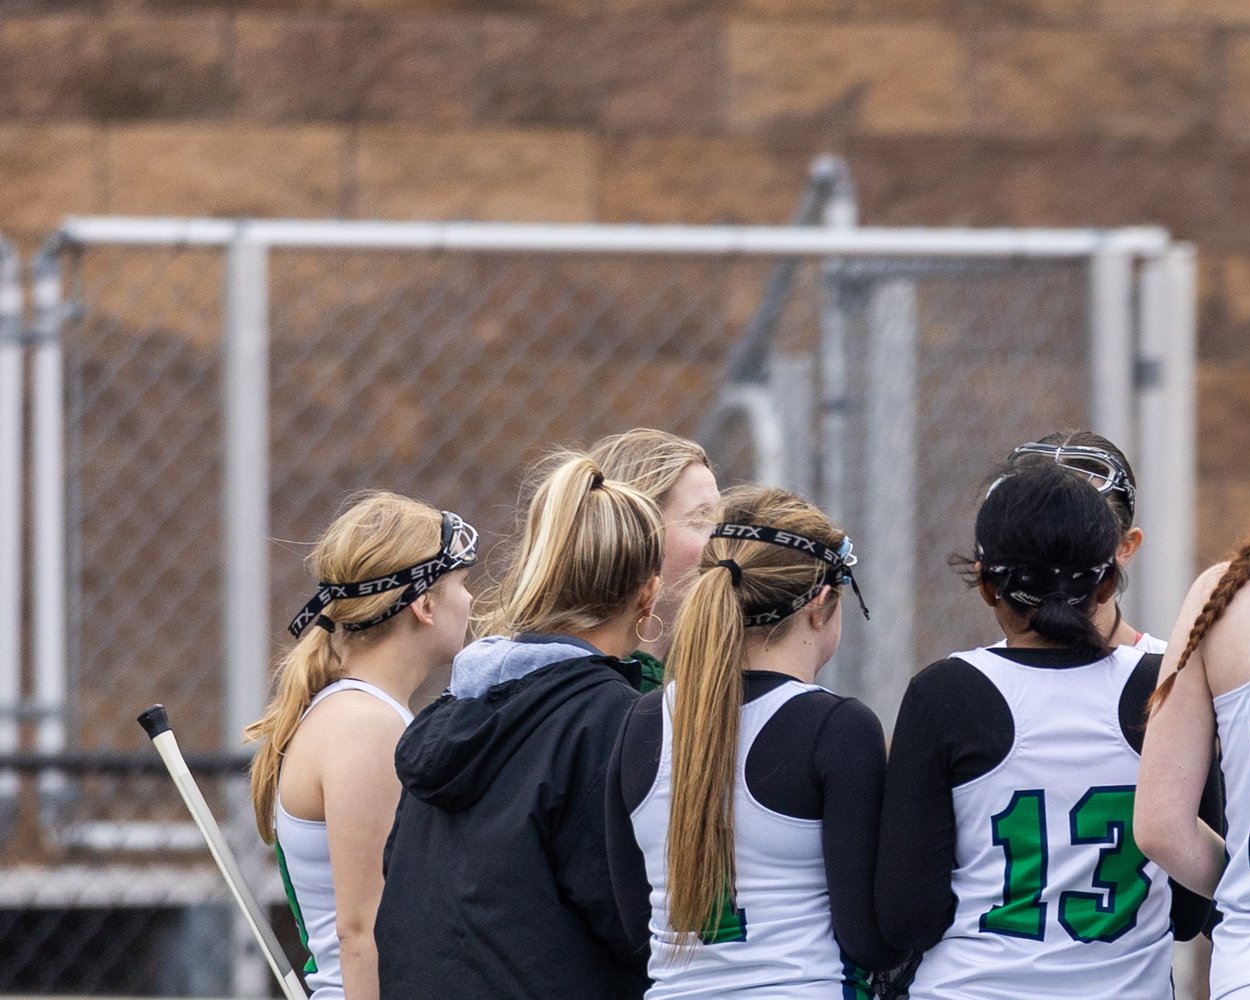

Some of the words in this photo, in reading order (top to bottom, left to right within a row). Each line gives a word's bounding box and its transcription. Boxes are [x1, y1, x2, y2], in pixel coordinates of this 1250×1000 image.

[722, 523, 763, 540] STX
[773, 530, 817, 554] STX
[823, 547, 842, 566] ST
[358, 574, 400, 596] STX
[410, 556, 448, 581] STX
[978, 784, 1153, 944] 13
